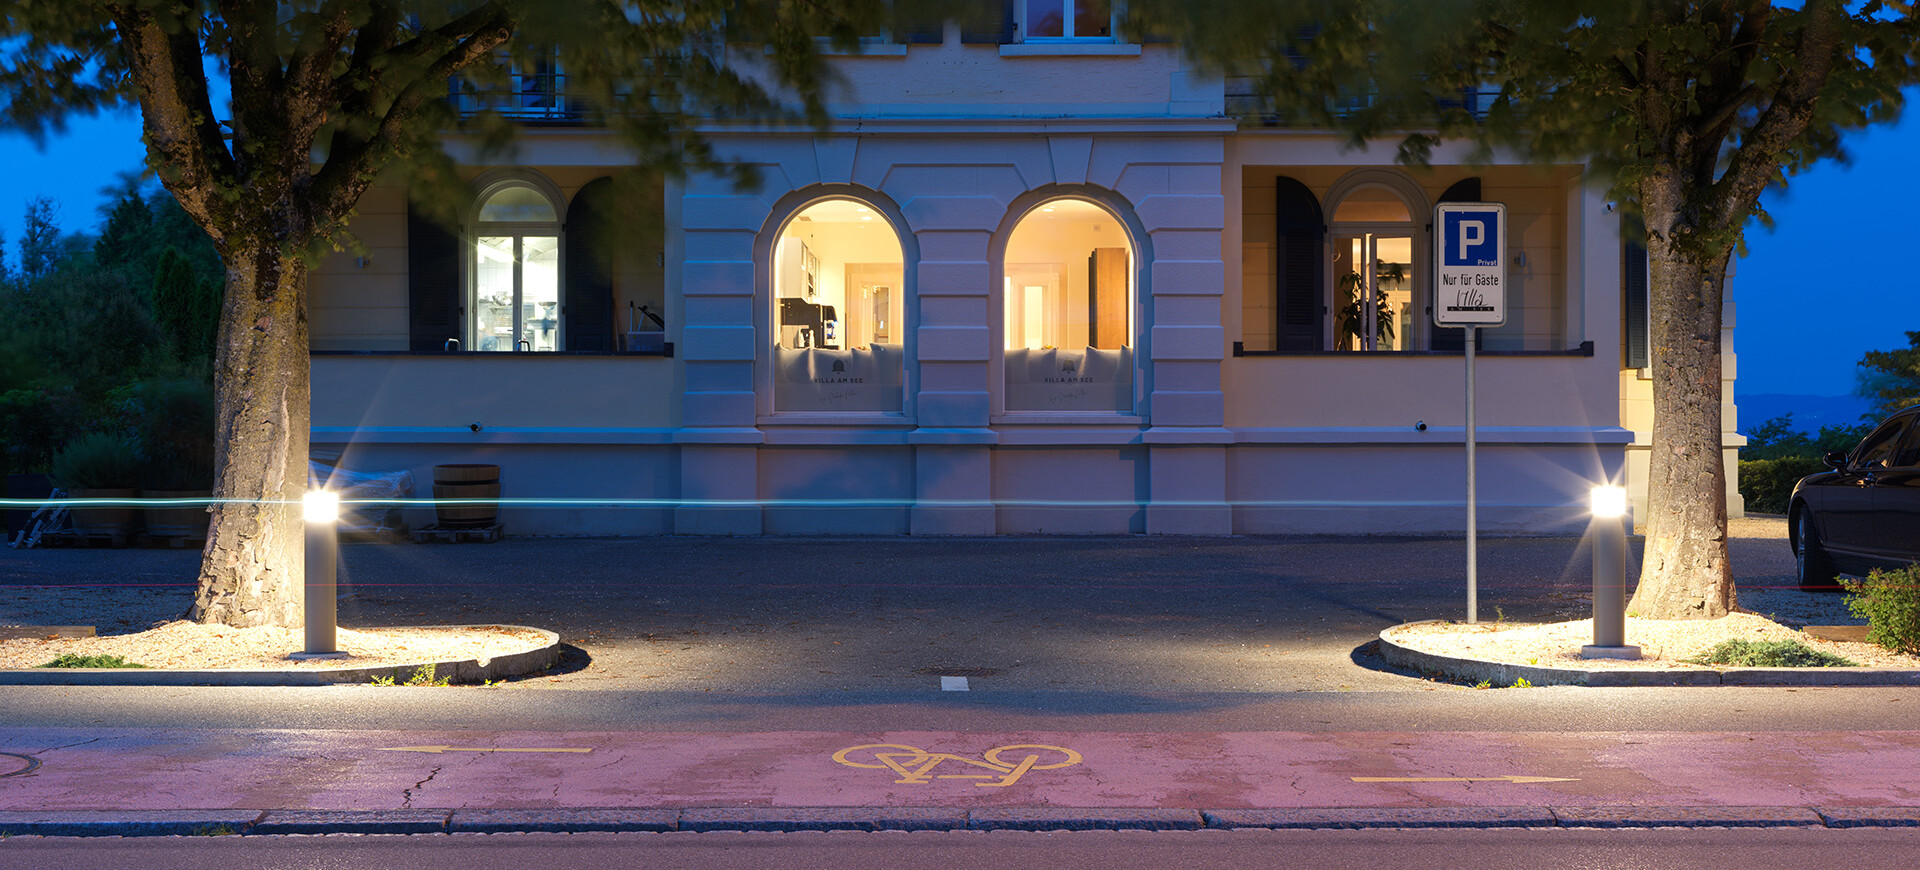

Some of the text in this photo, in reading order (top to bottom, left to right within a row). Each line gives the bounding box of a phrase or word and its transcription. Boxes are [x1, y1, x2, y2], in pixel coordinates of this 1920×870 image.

[1459, 220, 1485, 260] P
[1443, 274, 1499, 286] Nur für Gäste
